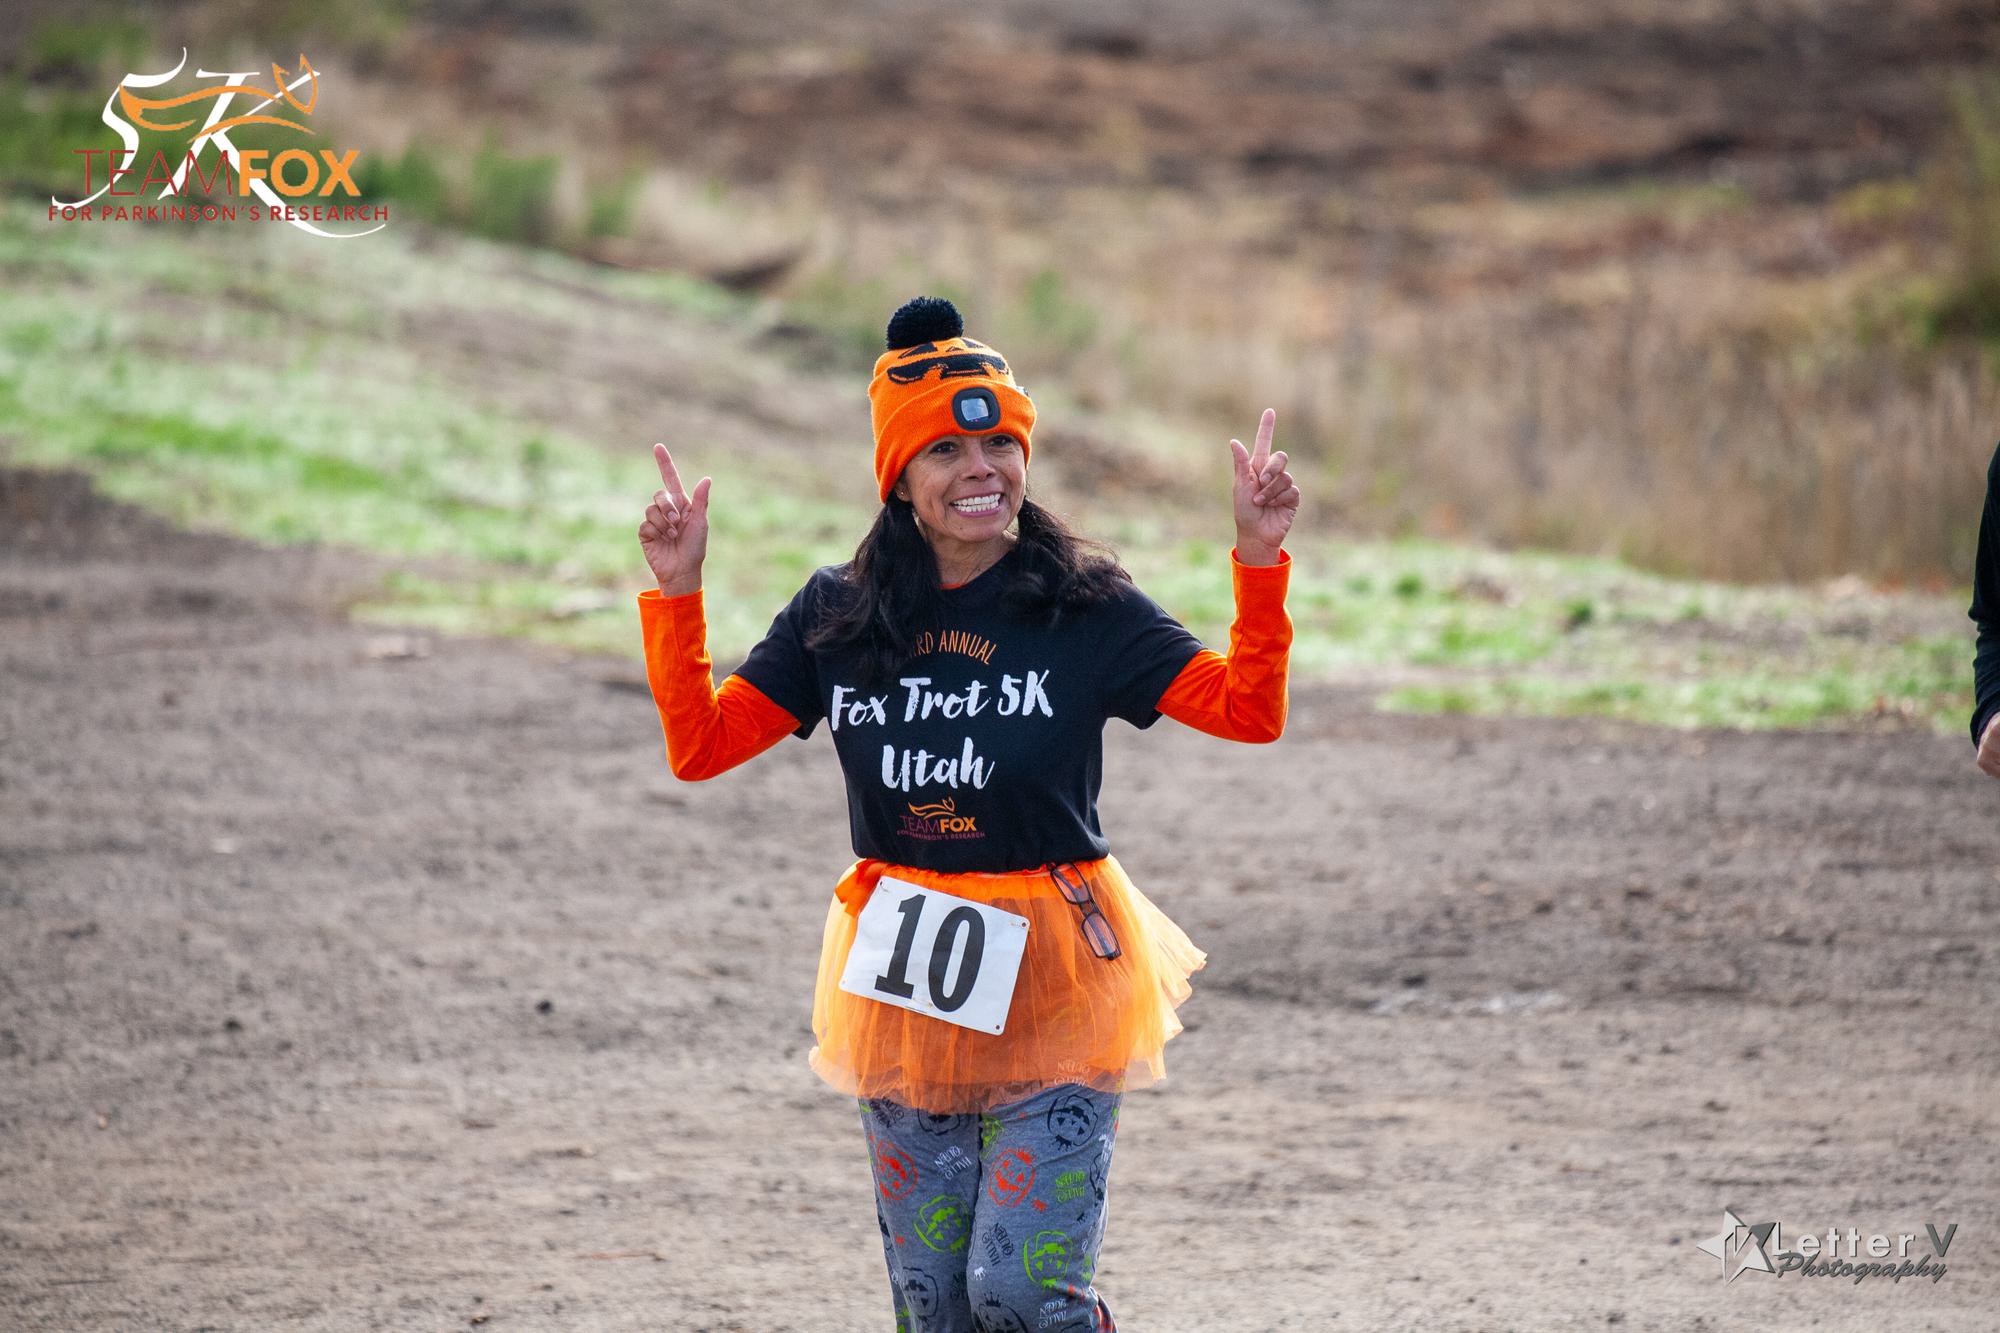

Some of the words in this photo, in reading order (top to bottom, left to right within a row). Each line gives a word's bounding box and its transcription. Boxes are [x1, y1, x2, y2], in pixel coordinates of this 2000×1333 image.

[938, 629, 997, 665] ANNUAL
[831, 684, 889, 731] Fox
[900, 677, 991, 723] Trot
[997, 669, 1054, 718] 5K
[881, 736, 995, 792] Utah
[950, 832, 986, 840] RESEARCH
[874, 893, 985, 1012] 10
